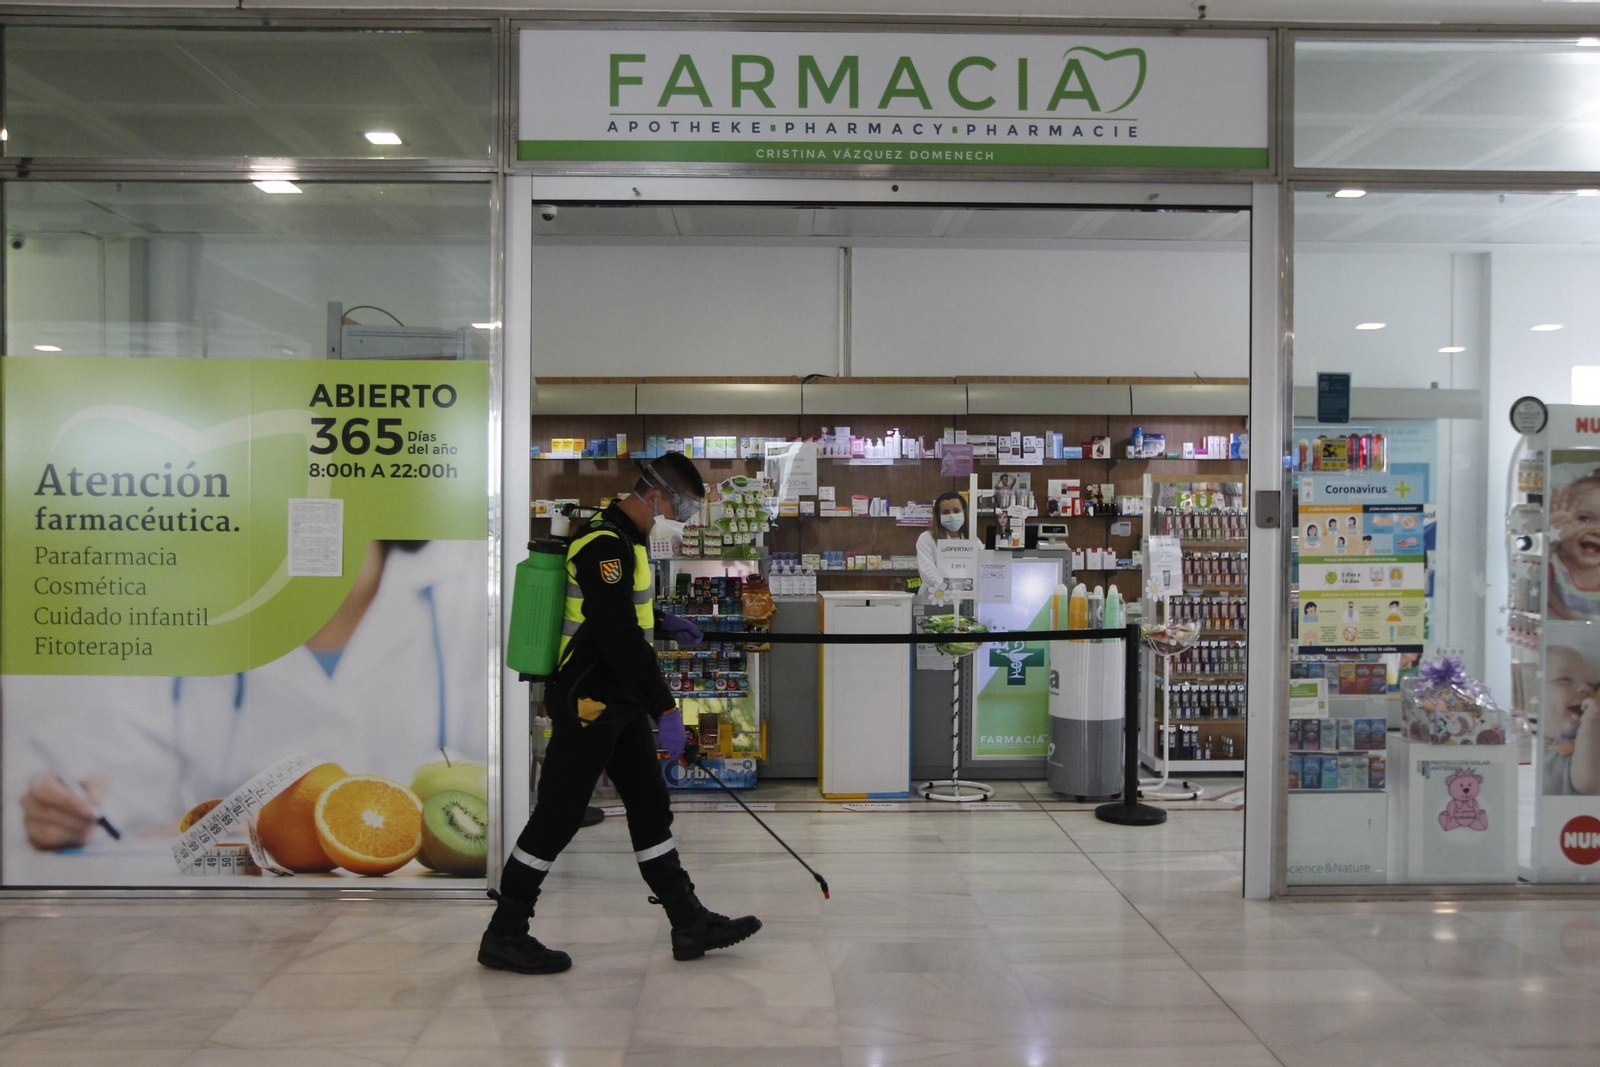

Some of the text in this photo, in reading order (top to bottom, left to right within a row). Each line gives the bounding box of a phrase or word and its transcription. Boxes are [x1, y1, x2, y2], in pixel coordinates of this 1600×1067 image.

[609, 53, 1102, 112] FARMACIA
[607, 121, 1138, 138] APOTHEKE PHARMACY PHARMACIE
[755, 147, 995, 161] CRISTINA VÁZQUEZ DOMENECH
[309, 384, 458, 408] ABIERTO
[309, 417, 404, 456] 365
[407, 430, 437, 443] Días
[407, 443, 458, 456] del año
[34, 461, 230, 498] Atención
[309, 463, 458, 478] 8:00h A 22:00h
[1325, 484, 1388, 494] Coronavirus
[35, 503, 241, 533] farmacéutica.
[35, 547, 178, 566] Parafarmacia
[35, 577, 147, 596] Cosmética
[34, 606, 210, 627] Cuidado infantil
[35, 637, 153, 660] Fitoterapia
[980, 735, 1045, 744] FARMACIA
[666, 762, 719, 783] Orbit
